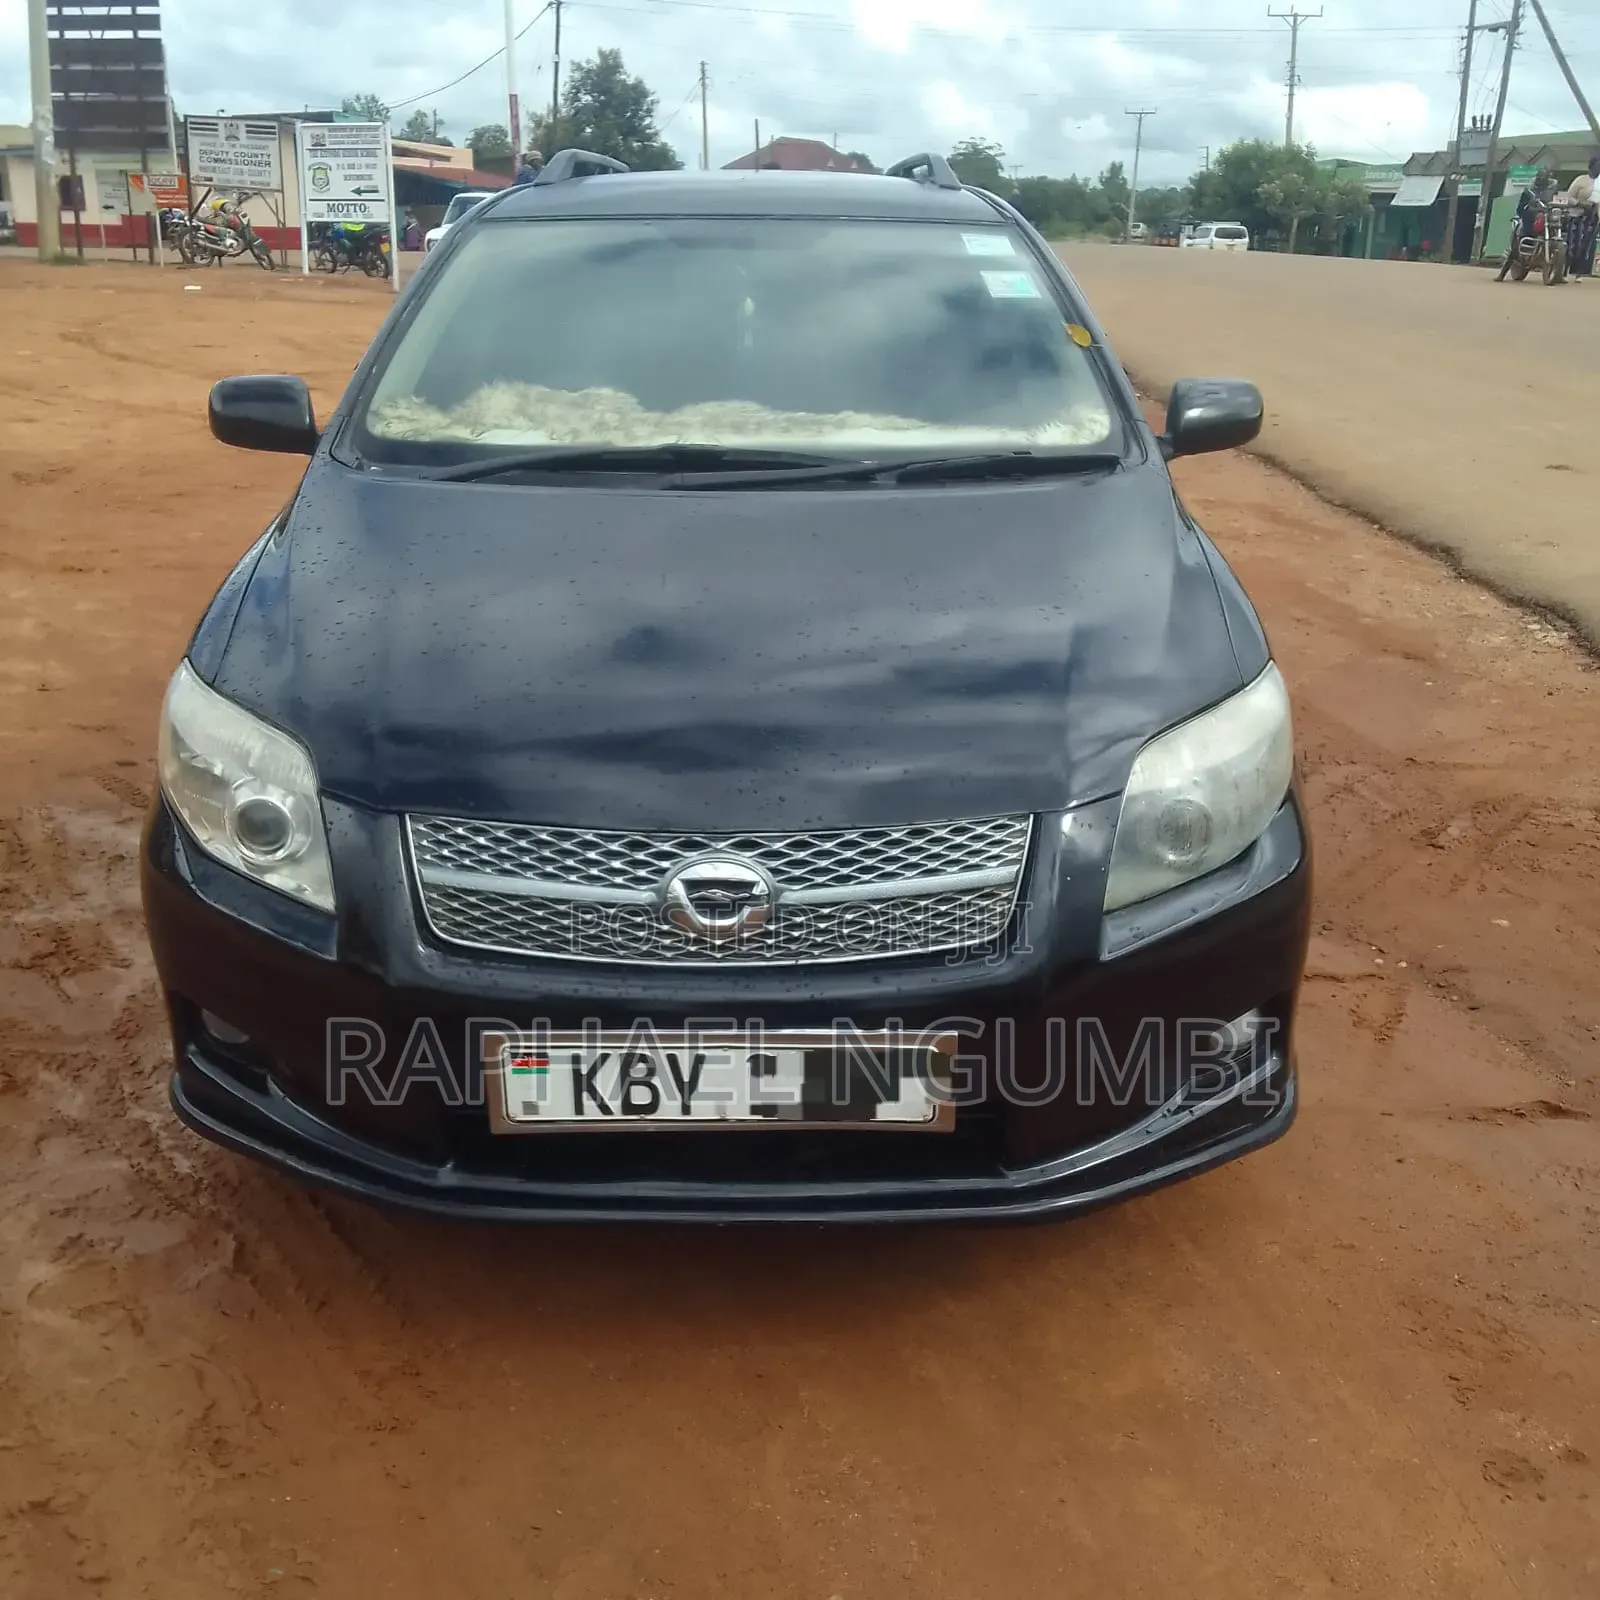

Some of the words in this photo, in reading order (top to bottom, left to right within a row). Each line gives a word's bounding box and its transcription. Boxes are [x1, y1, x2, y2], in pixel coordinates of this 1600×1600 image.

[198, 149, 229, 157] DEPUTY
[233, 151, 272, 160] COUNTY
[198, 156, 272, 168] COMMISSIONER
[326, 203, 370, 213] MOTTO:
[570, 1051, 708, 1117] KBY
